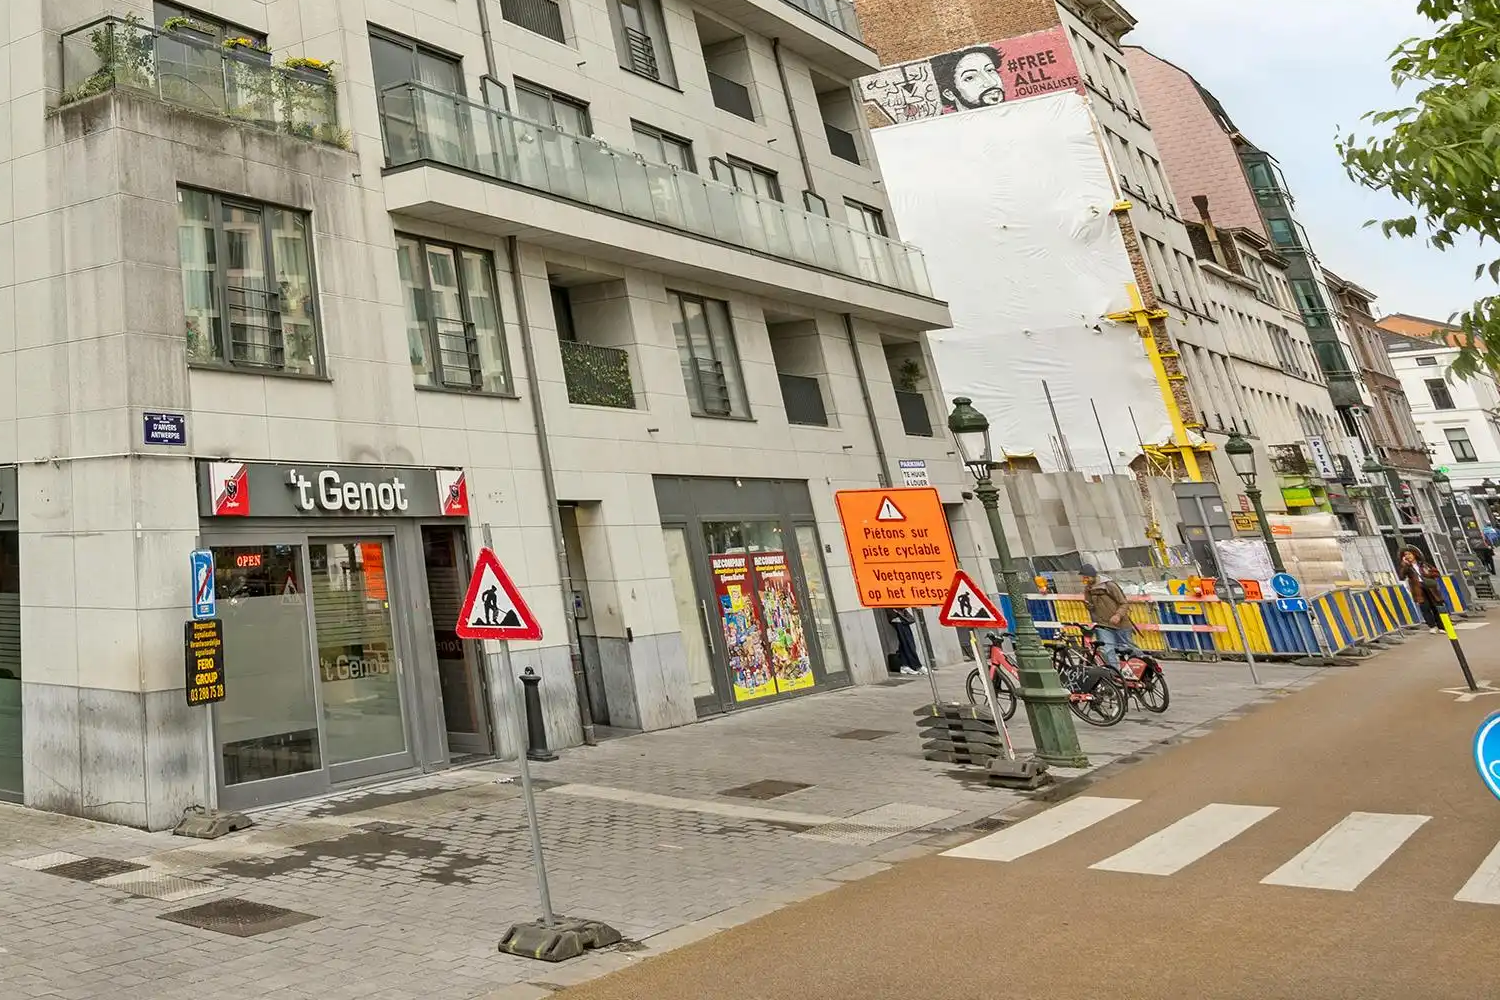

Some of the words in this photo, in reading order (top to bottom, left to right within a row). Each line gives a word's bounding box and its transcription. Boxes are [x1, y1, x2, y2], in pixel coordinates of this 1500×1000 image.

[1007, 49, 1057, 73] #FREE
[1013, 70, 1052, 88] ALL
[1014, 75, 1079, 98] JOURNALISTS
[153, 423, 177, 431] D'ANVERS
[151, 431, 180, 440] ANTWERPSE
[1312, 441, 1331, 473] PITTA
[290, 468, 315, 511] 't
[318, 470, 408, 511] Genot
[863, 527, 905, 539] Piétons
[911, 528, 928, 538] sur
[862, 544, 890, 559] piste
[896, 543, 941, 558] cyclable
[237, 554, 261, 567] OPEN
[873, 569, 943, 584] Voetgangers
[868, 589, 882, 601] op
[887, 587, 906, 599] het
[910, 586, 950, 600] fietspa
[197, 658, 214, 671] FERO
[336, 654, 388, 680] Genot
[195, 671, 218, 686] GROUP
[190, 688, 199, 702] 03
[209, 685, 217, 699] 75
[216, 684, 224, 698] 28
